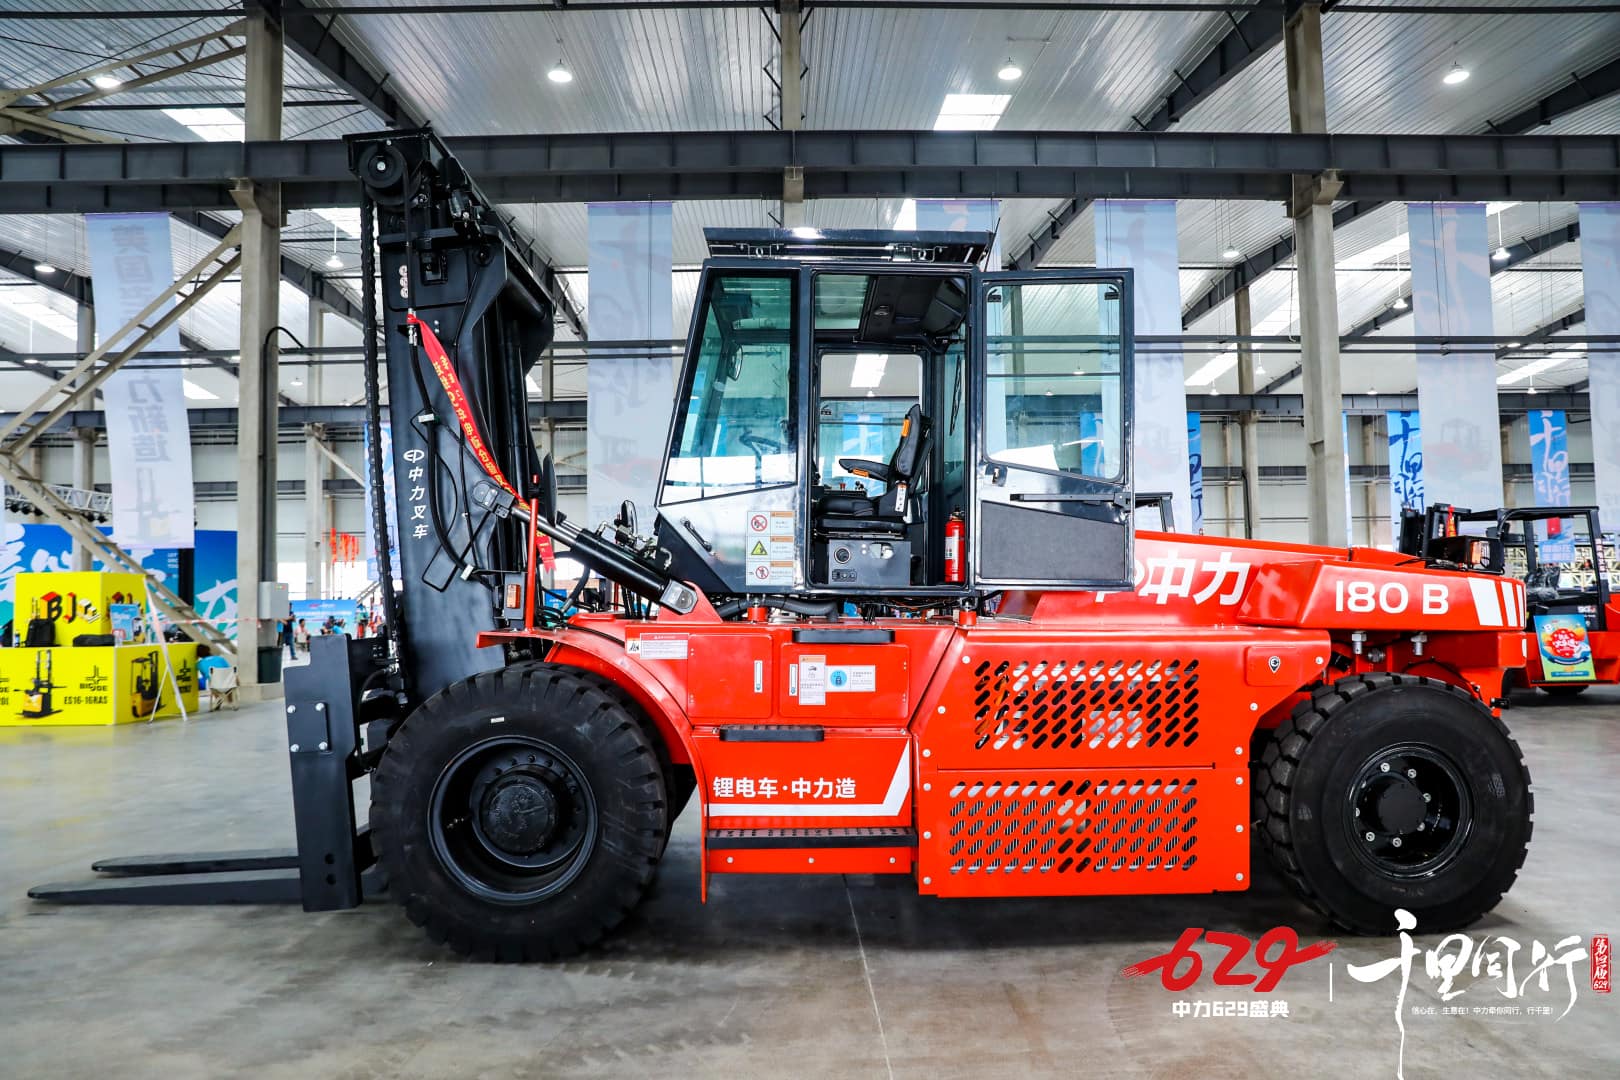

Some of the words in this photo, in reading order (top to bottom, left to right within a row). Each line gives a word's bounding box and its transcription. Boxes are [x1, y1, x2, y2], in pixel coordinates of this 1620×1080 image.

[408, 466, 429, 540] 中力叉车
[1138, 548, 1250, 606] 中力
[1335, 580, 1408, 614] 180
[1422, 583, 1449, 615] B
[713, 776, 857, 799] 锂电车·中力造
